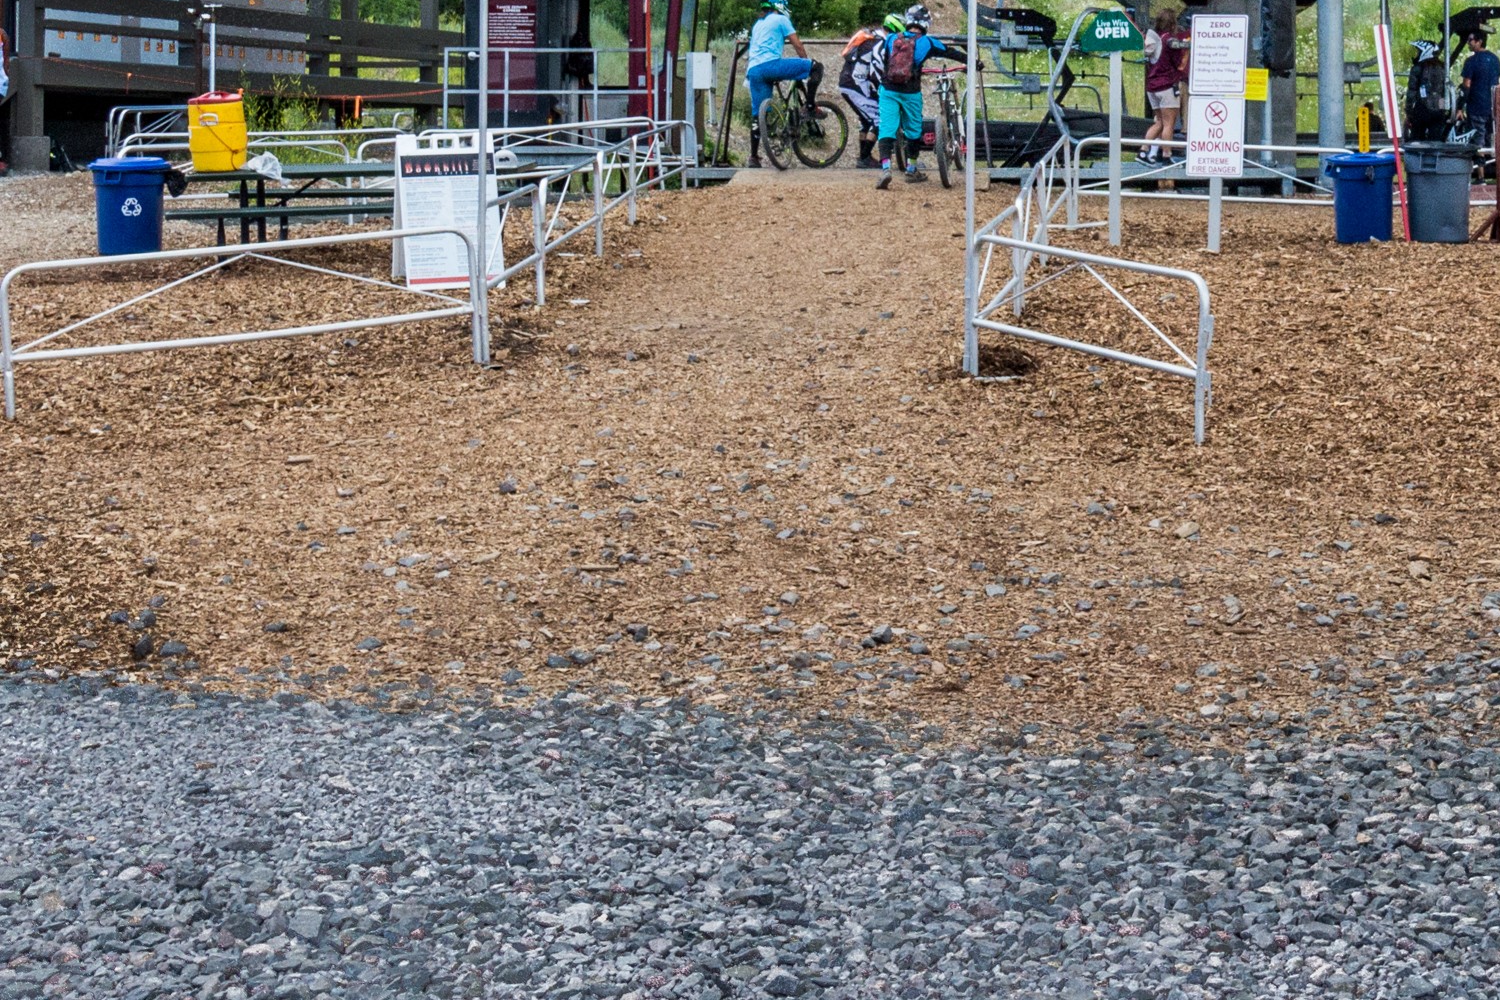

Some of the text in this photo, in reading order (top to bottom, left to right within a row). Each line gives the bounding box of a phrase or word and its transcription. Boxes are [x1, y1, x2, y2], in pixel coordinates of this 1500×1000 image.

[1096, 19, 1129, 27] Live Wire
[1095, 26, 1130, 39] OPEN
[1197, 31, 1243, 39] TOLERANCE
[1208, 127, 1224, 139] NO
[1190, 140, 1240, 153] SMOKING
[1198, 157, 1229, 165] EXTREME
[405, 161, 469, 174] Downhill
[1192, 165, 1237, 174] FIRE DANGER
